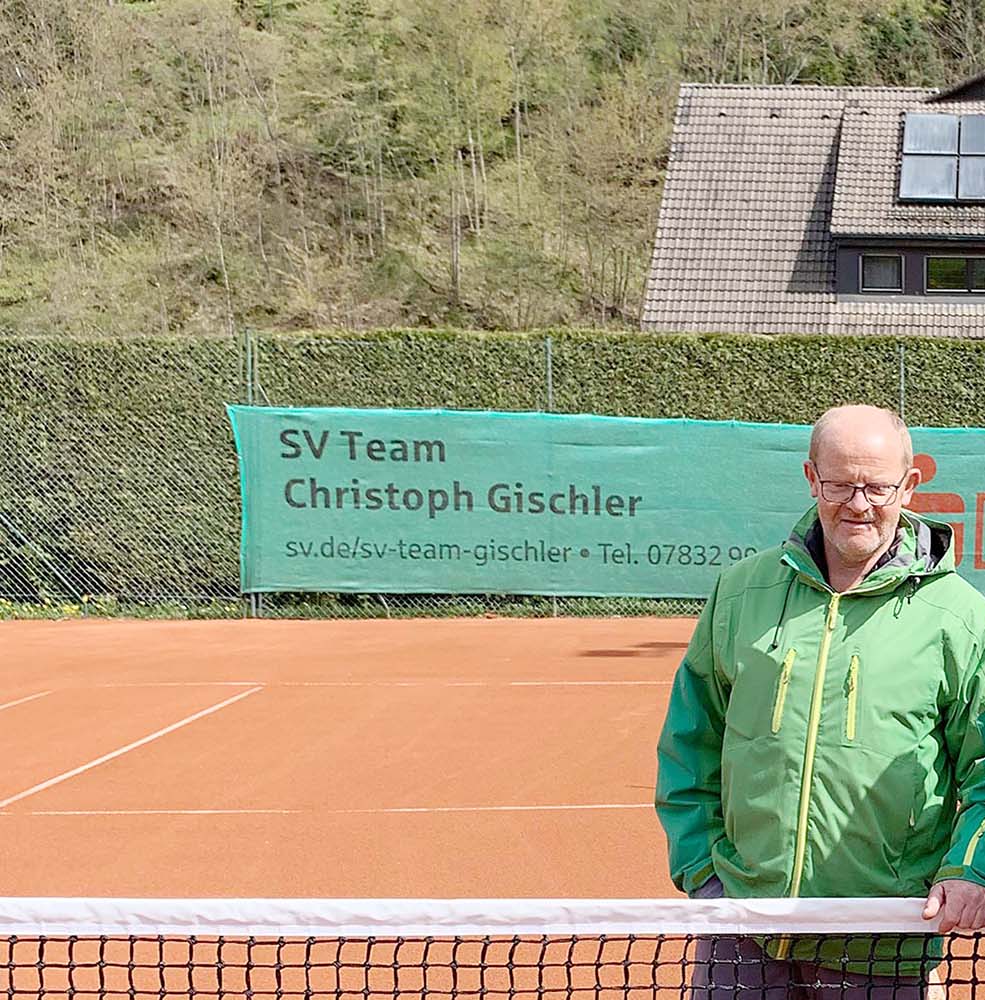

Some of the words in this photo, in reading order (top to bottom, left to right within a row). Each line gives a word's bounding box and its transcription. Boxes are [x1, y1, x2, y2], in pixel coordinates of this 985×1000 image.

[280, 429, 329, 460] SV
[340, 430, 446, 462] Team
[284, 477, 475, 519] Christoph
[488, 482, 643, 517] Gischler
[285, 536, 572, 566] sv.de/sv-team-gischler
[599, 543, 638, 565] Tel.
[647, 545, 721, 567] 07832
